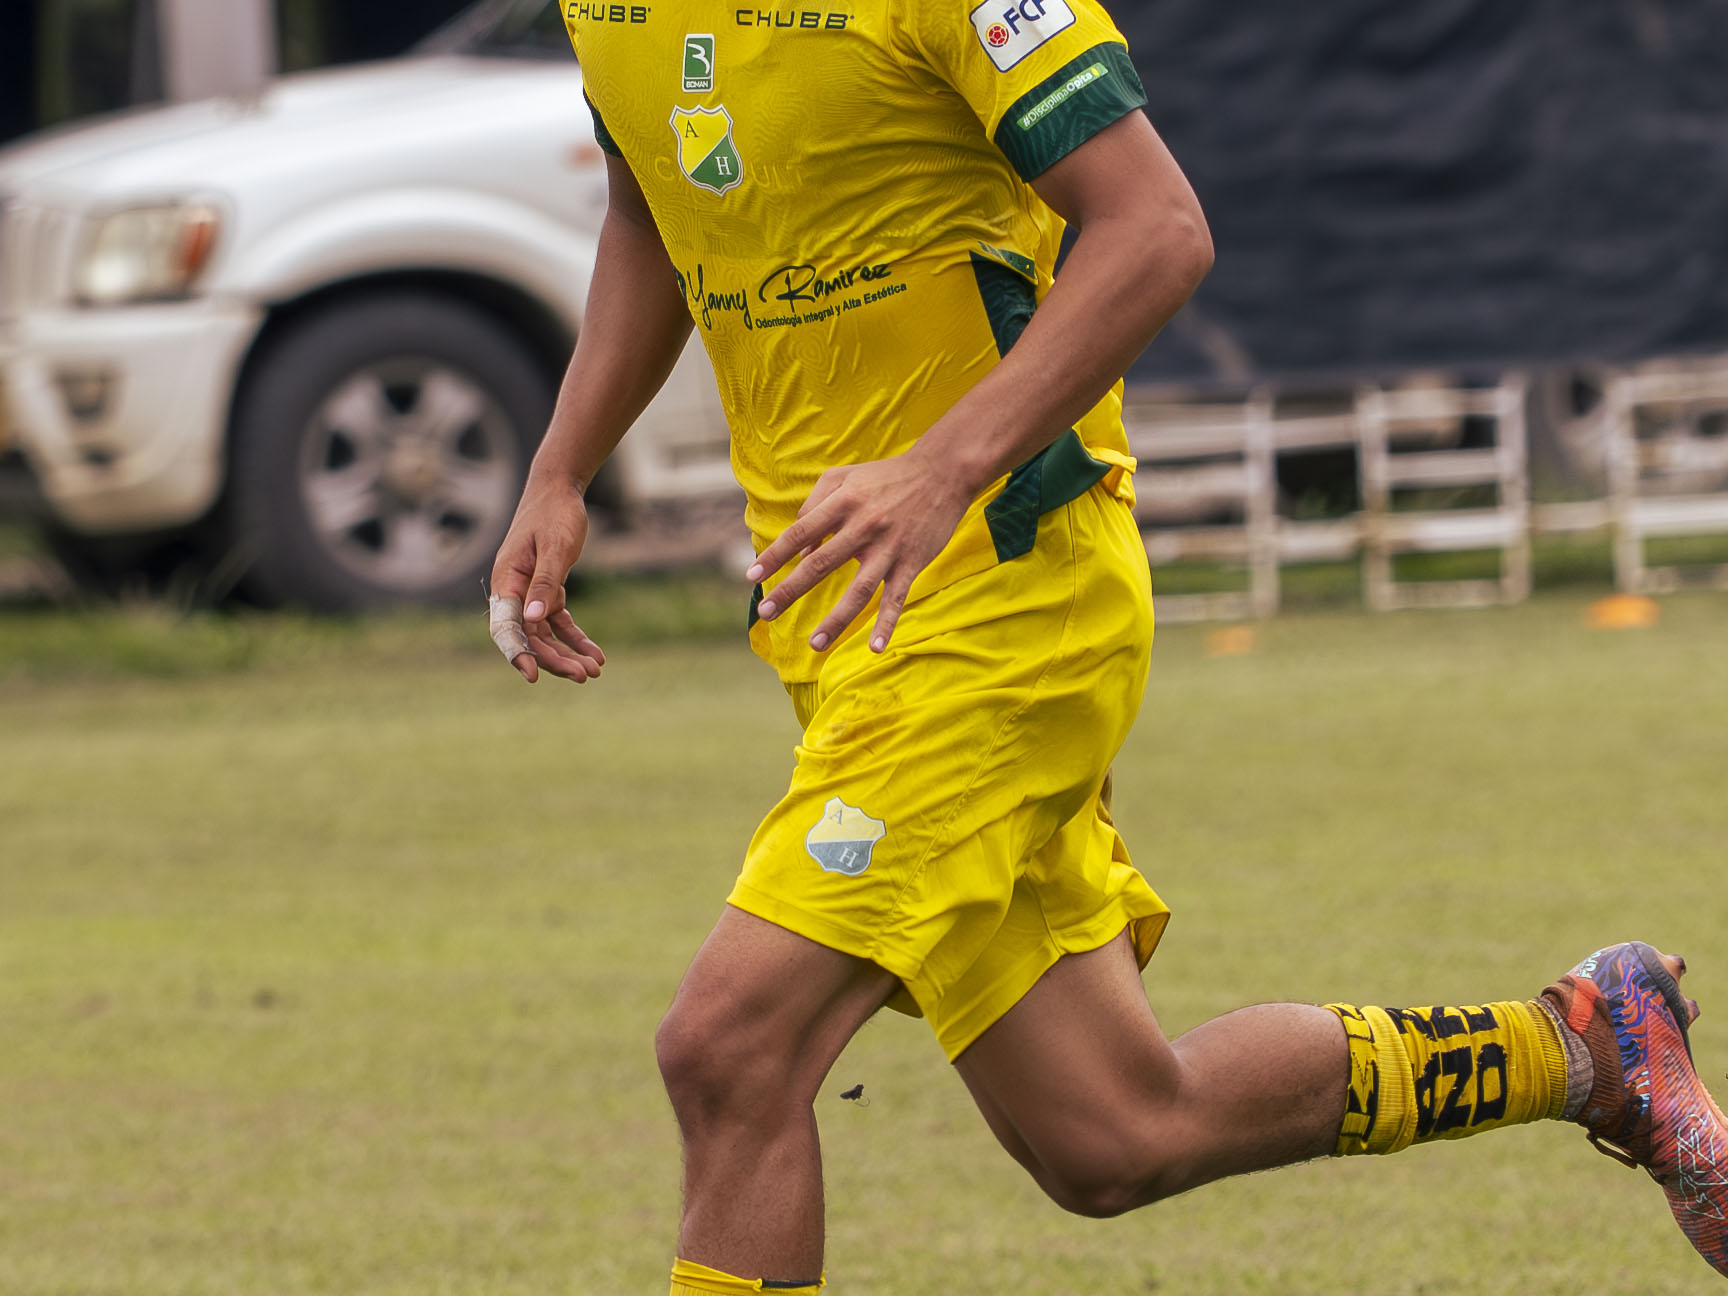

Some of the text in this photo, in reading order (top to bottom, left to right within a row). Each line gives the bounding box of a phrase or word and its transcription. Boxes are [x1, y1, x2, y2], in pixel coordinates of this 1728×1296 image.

[568, 2, 648, 24] CHUBB
[736, 9, 849, 30] CHUBB
[684, 119, 700, 138] A
[714, 156, 733, 176] H
[842, 298, 862, 312] Alta
[838, 847, 859, 868] H
